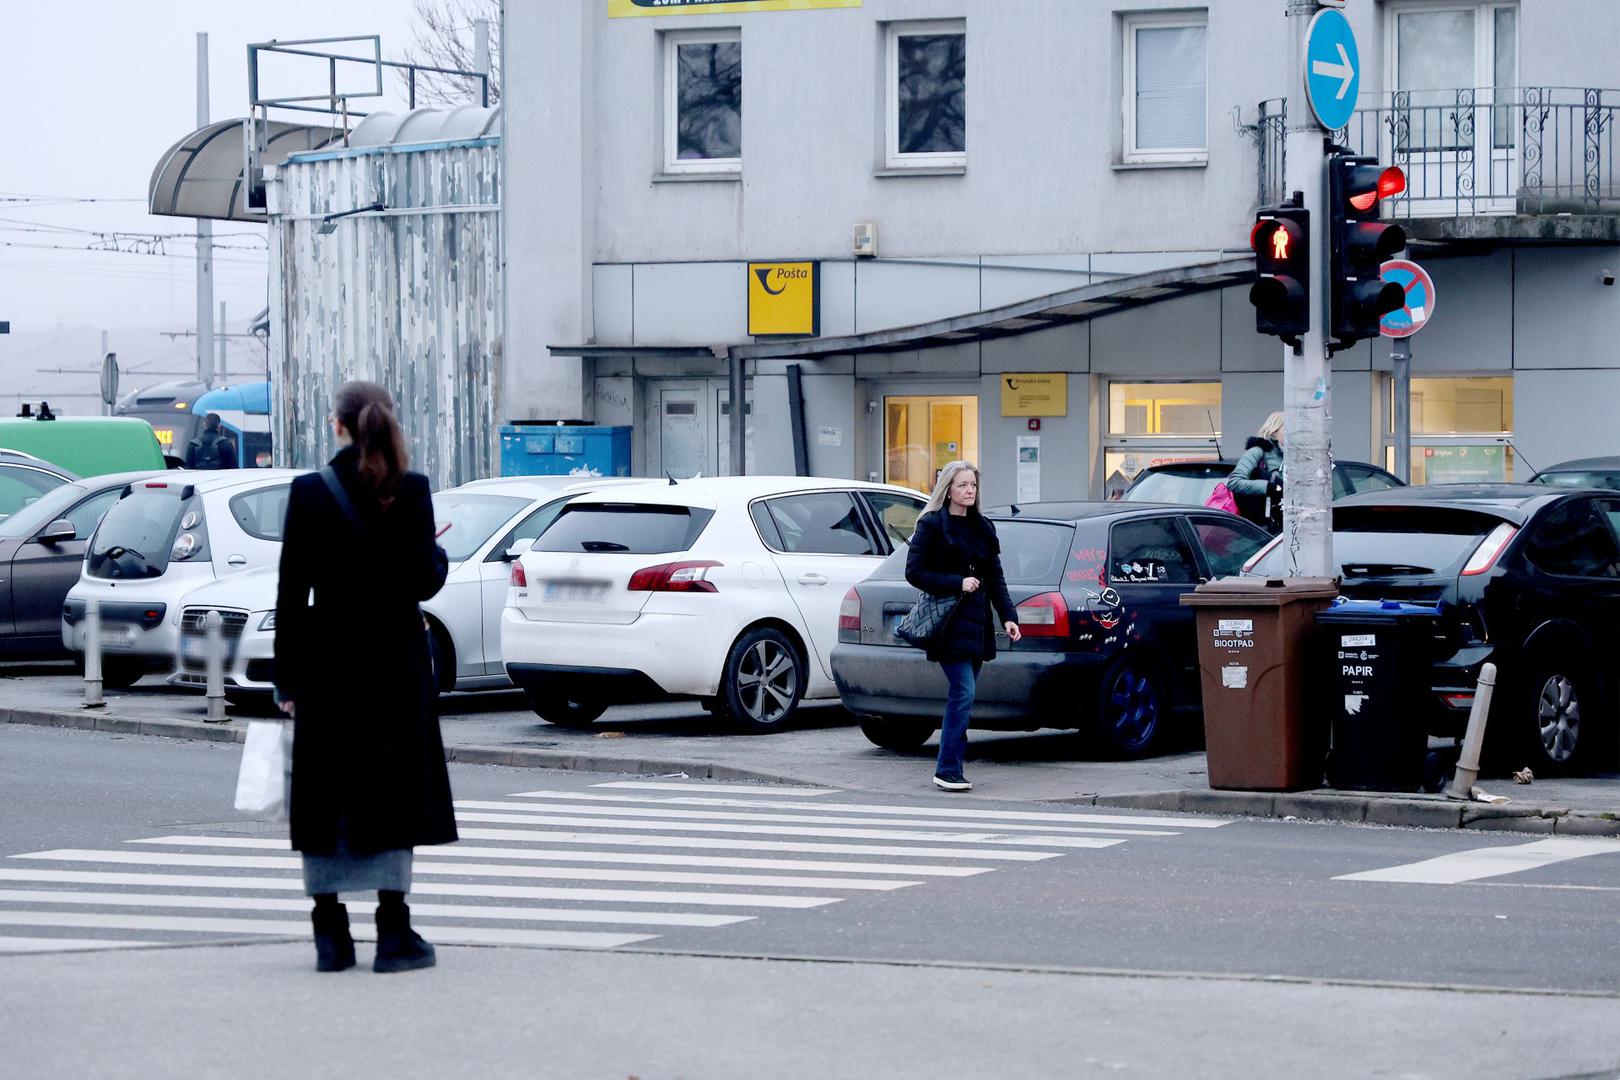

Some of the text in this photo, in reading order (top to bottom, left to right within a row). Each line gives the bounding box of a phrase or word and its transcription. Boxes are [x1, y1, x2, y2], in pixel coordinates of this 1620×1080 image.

[777, 268, 807, 279] Pošta
[1214, 640, 1254, 648] BIOOTPAD
[1342, 665, 1373, 676] PAPIR
